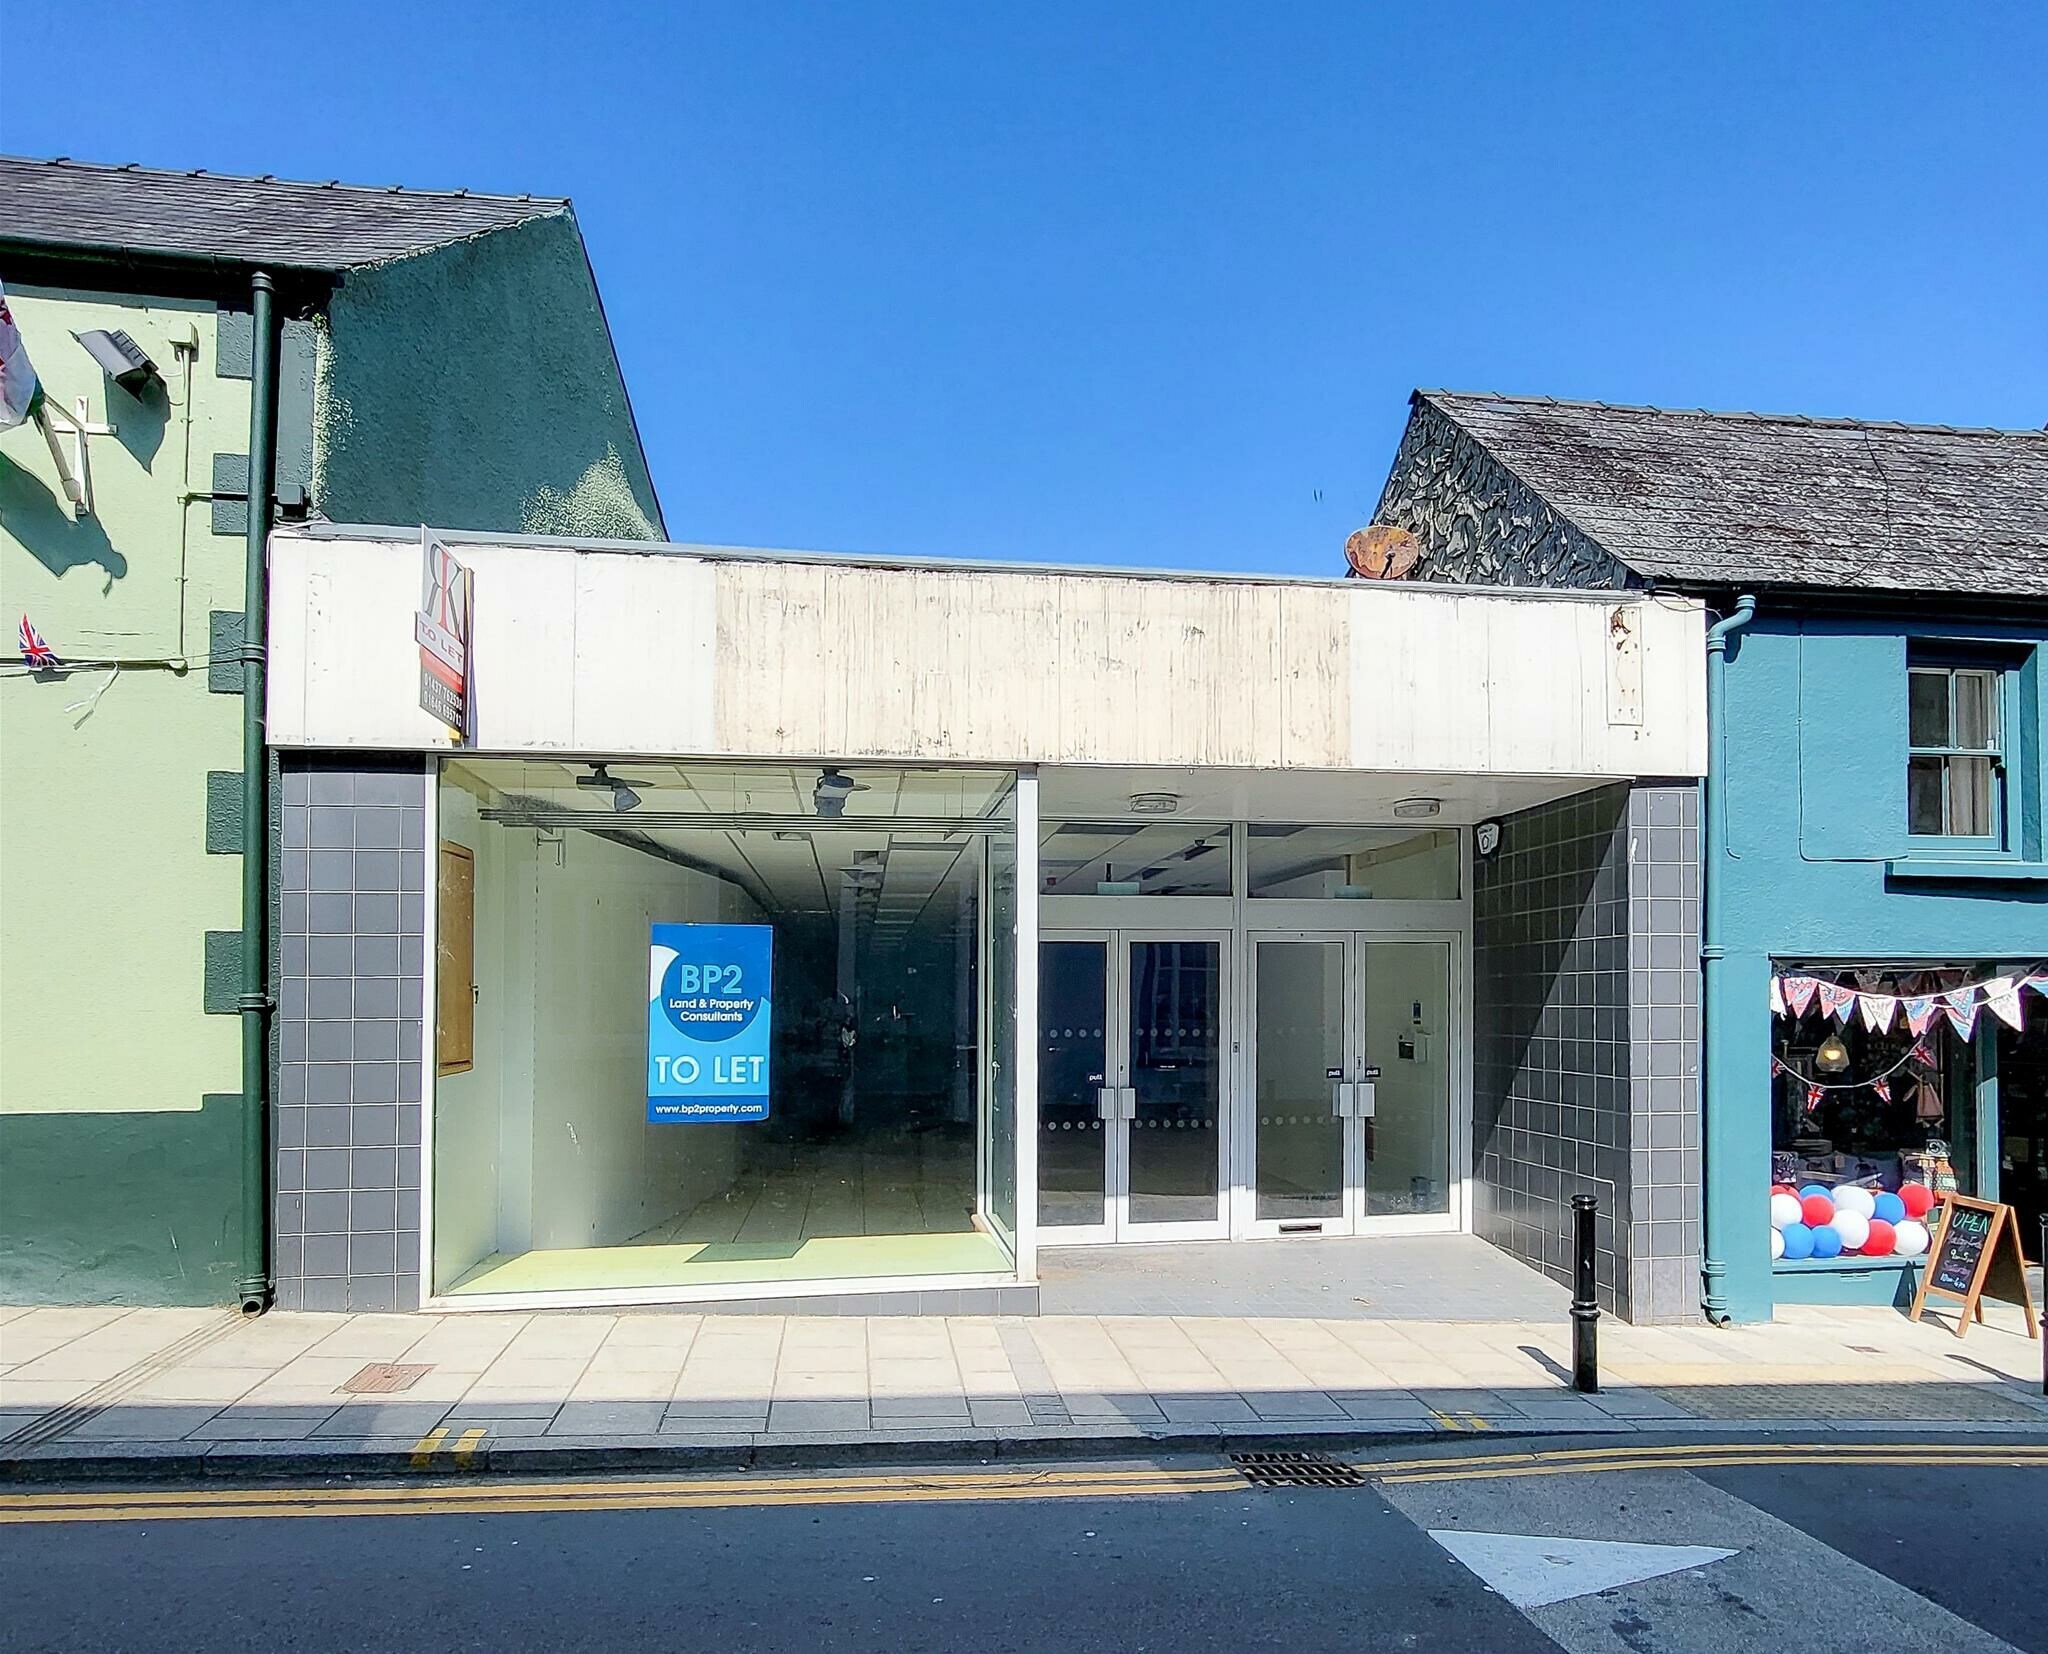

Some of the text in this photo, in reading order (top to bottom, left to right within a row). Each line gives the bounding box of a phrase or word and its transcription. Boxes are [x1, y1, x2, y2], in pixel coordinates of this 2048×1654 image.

[419, 620, 463, 664] TO LET
[680, 964, 743, 995] BP2
[669, 998, 754, 1012] Land & Property
[680, 1011, 744, 1023] Consultants
[654, 1055, 765, 1085] TO LET
[1089, 1073, 1103, 1081] pull
[655, 1103, 763, 1116] www.bp2property.com
[1952, 1212, 1991, 1235] OPEN
